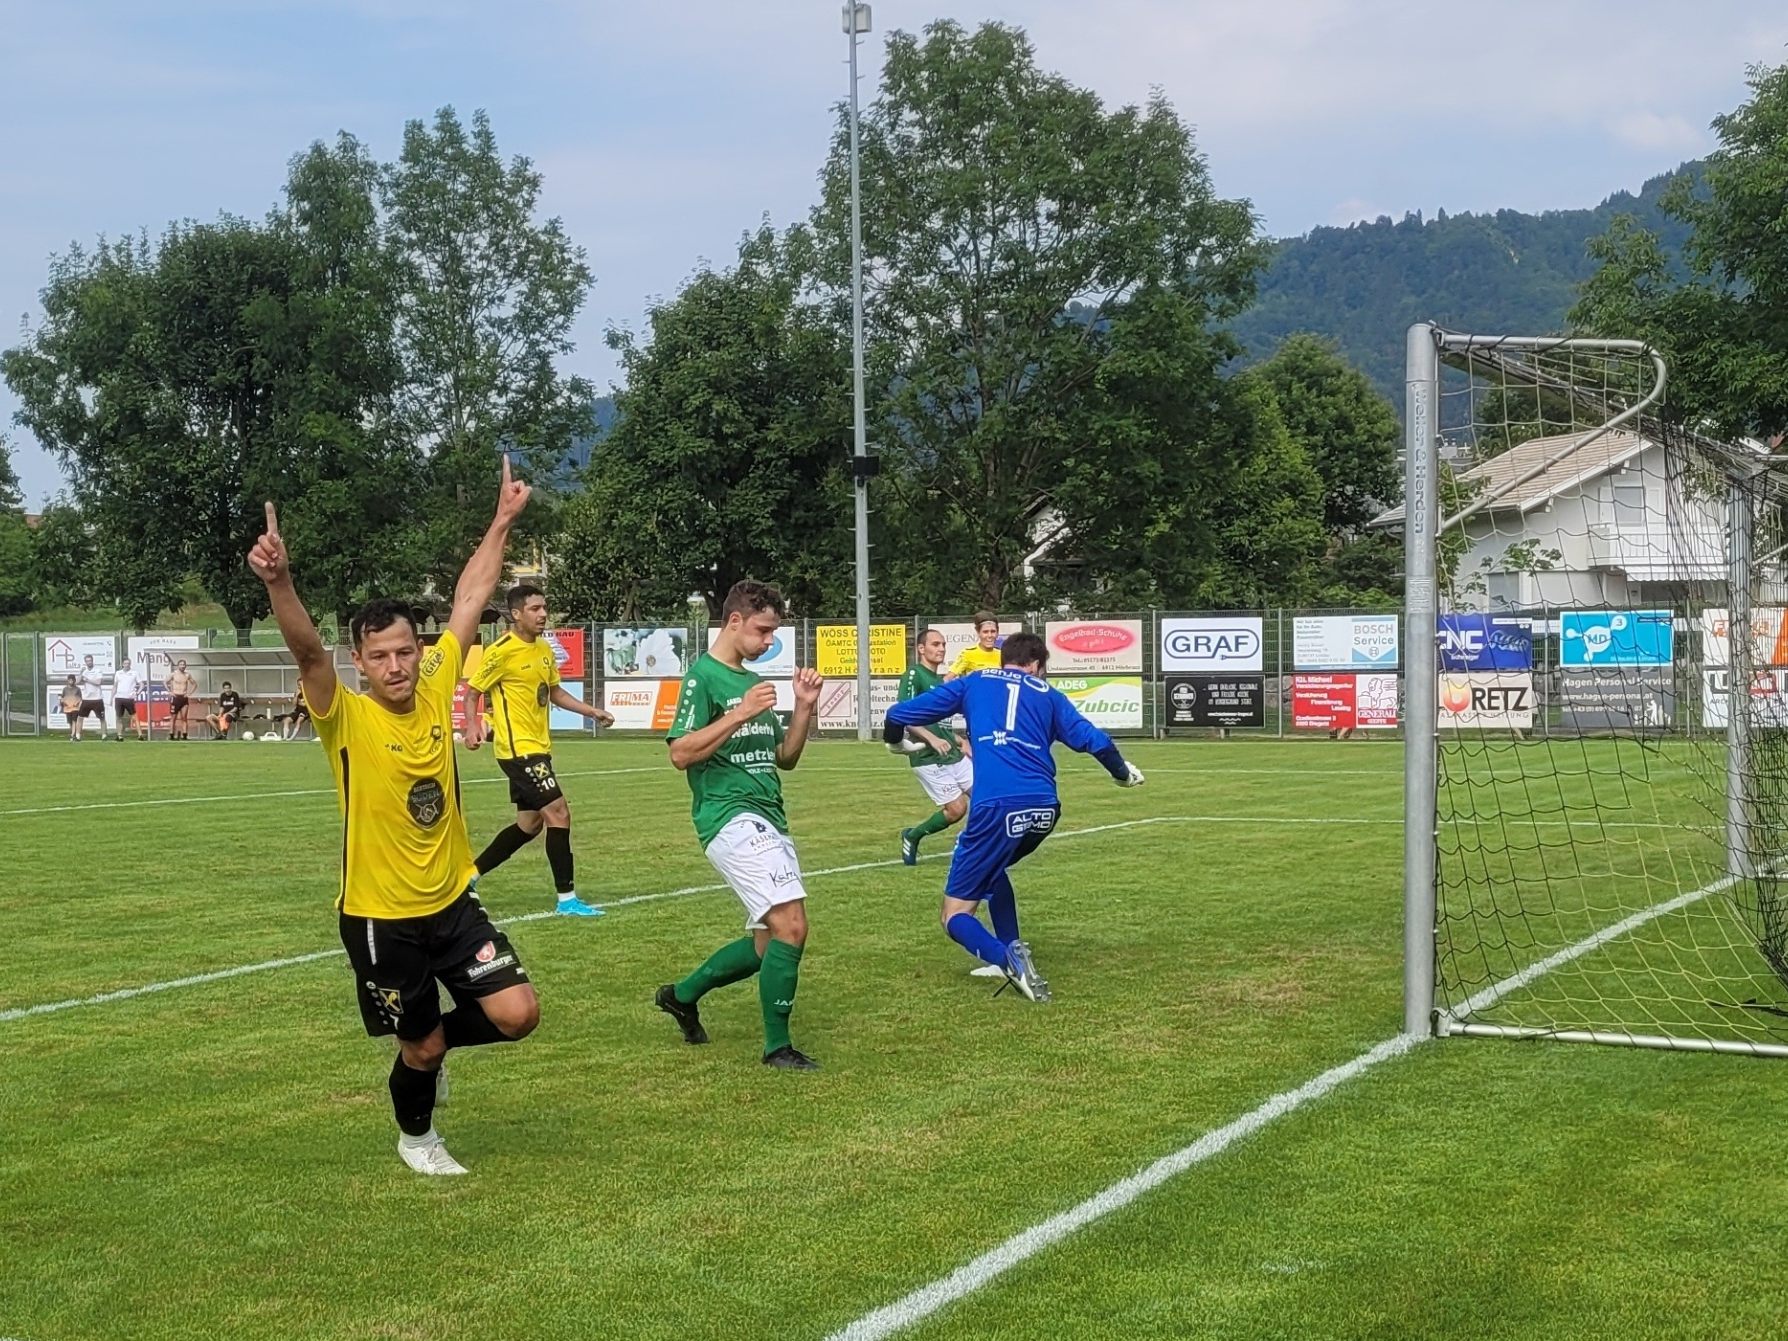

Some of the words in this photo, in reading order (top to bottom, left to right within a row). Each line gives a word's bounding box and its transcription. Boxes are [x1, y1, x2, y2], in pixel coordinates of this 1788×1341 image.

[1415, 466, 1426, 534] Herden
[851, 627, 902, 638] CISTINE
[1354, 624, 1393, 634] BOSCH
[946, 634, 979, 642] EGEN
[1354, 636, 1394, 646] Service
[1171, 635, 1249, 653] GRAF
[870, 647, 886, 655] OTO
[823, 666, 843, 674] 6912
[1057, 680, 1088, 690] ADEG
[1562, 678, 1593, 688] Hagen
[1594, 677, 1635, 687] Personal
[1637, 677, 1672, 686] Service
[611, 692, 650, 703] FRIMA
[1471, 687, 1529, 711] RETZ
[1006, 683, 1020, 731] 1
[1076, 699, 1140, 713] Zubcic
[1358, 709, 1397, 719] GENERALI
[730, 747, 776, 763] metzle
[541, 777, 556, 791] 10
[467, 954, 514, 978] Fohrenburge
